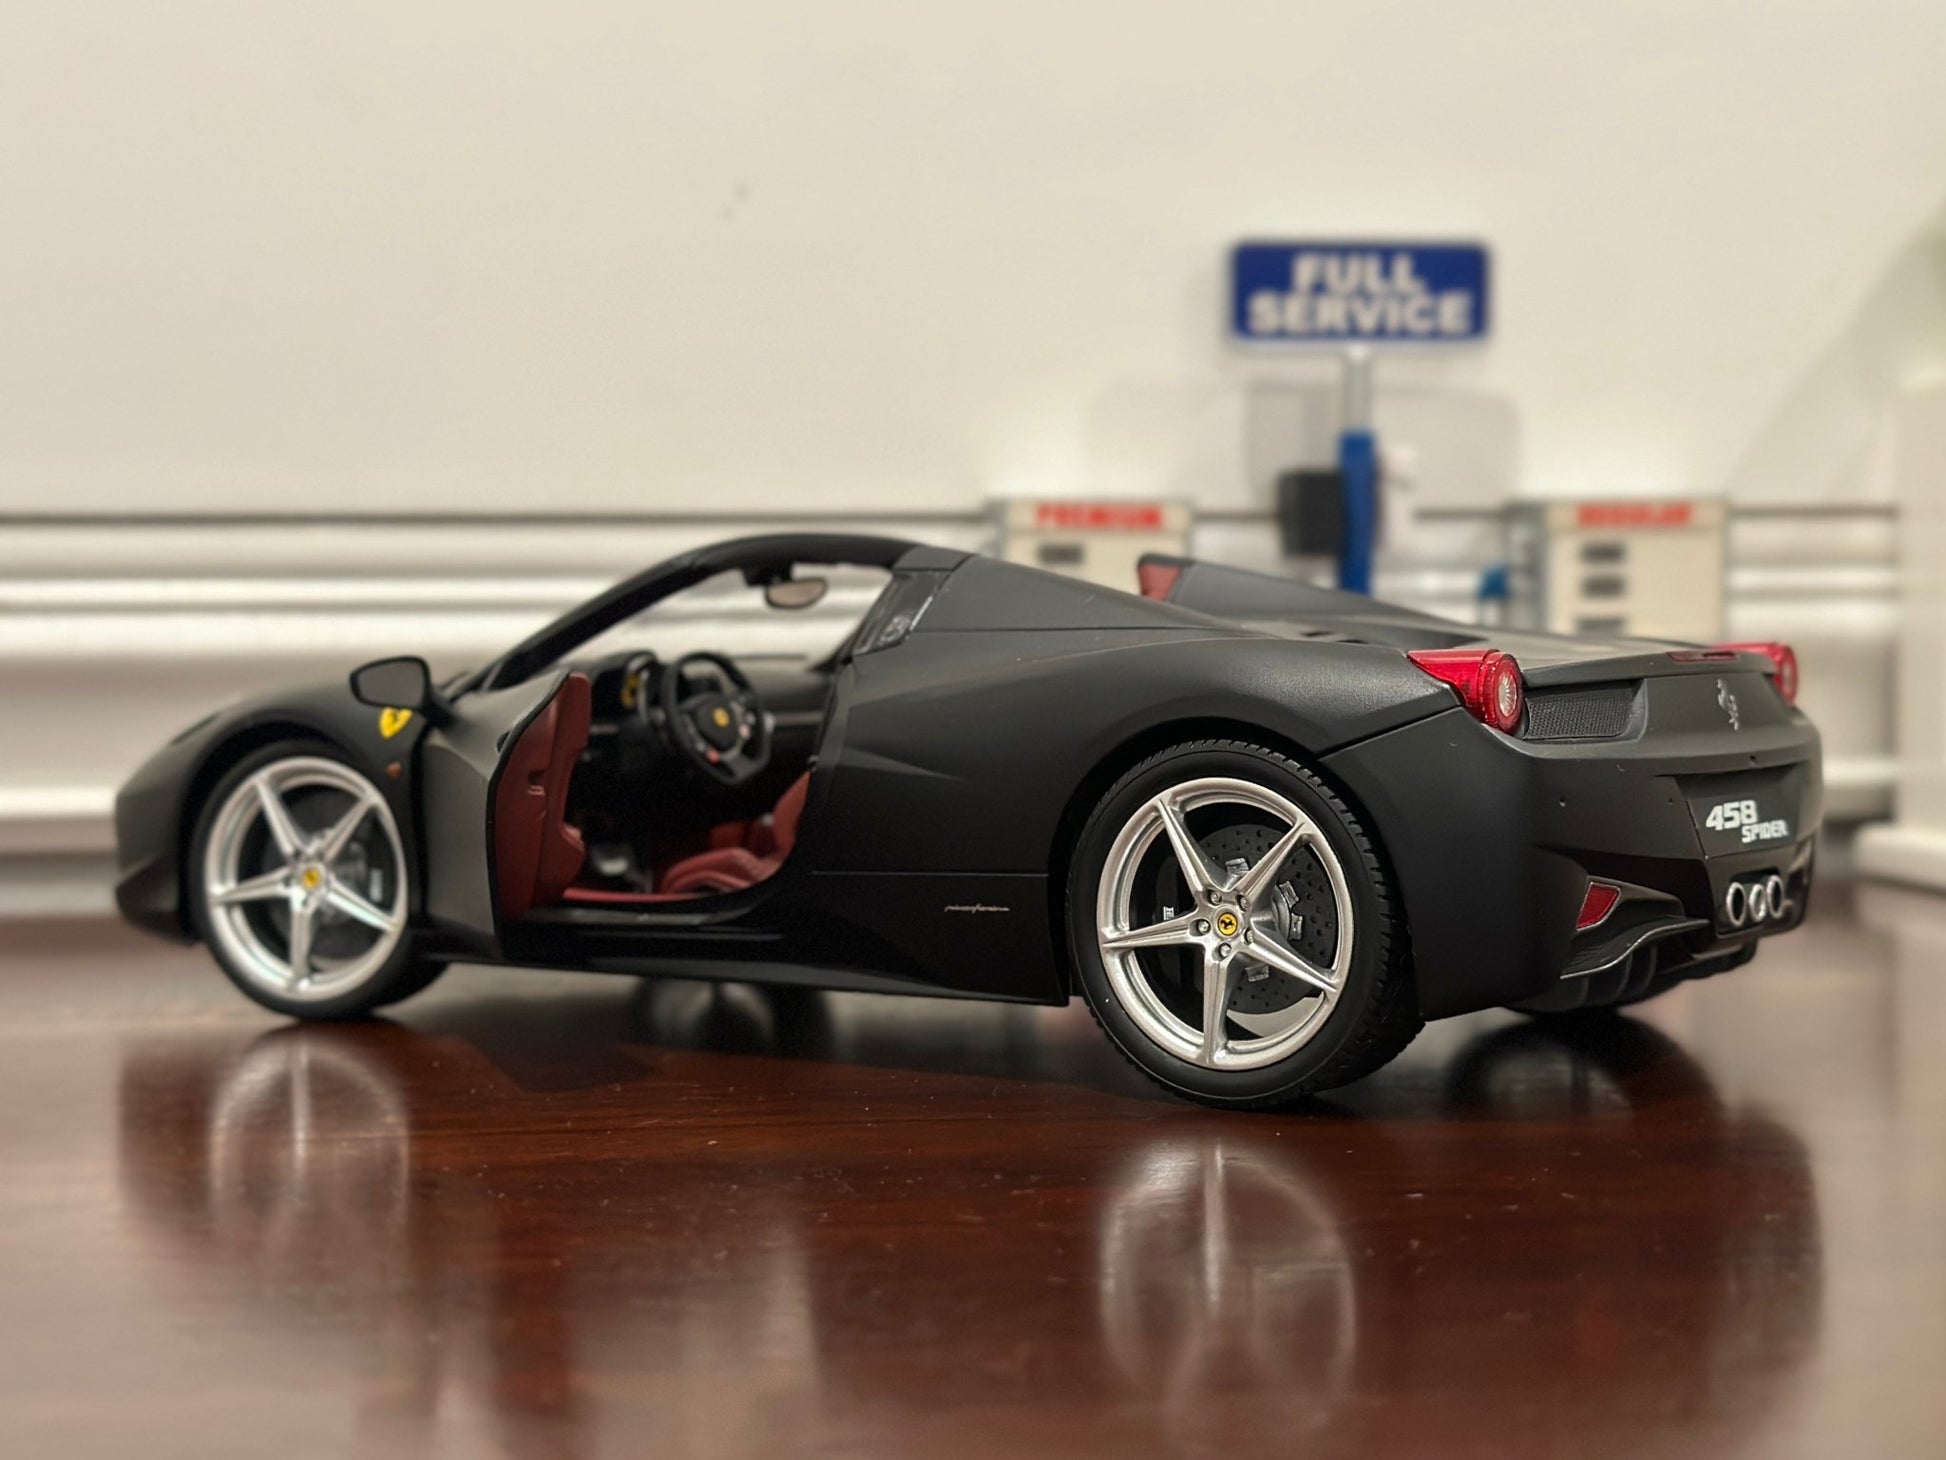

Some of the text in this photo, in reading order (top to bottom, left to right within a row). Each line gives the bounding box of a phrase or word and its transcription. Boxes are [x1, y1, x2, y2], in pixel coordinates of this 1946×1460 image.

[1292, 254, 1425, 292] FULL
[1250, 292, 1471, 334] SERVICE
[1705, 800, 1757, 830] 458
[1741, 820, 1788, 843] SPIDER
